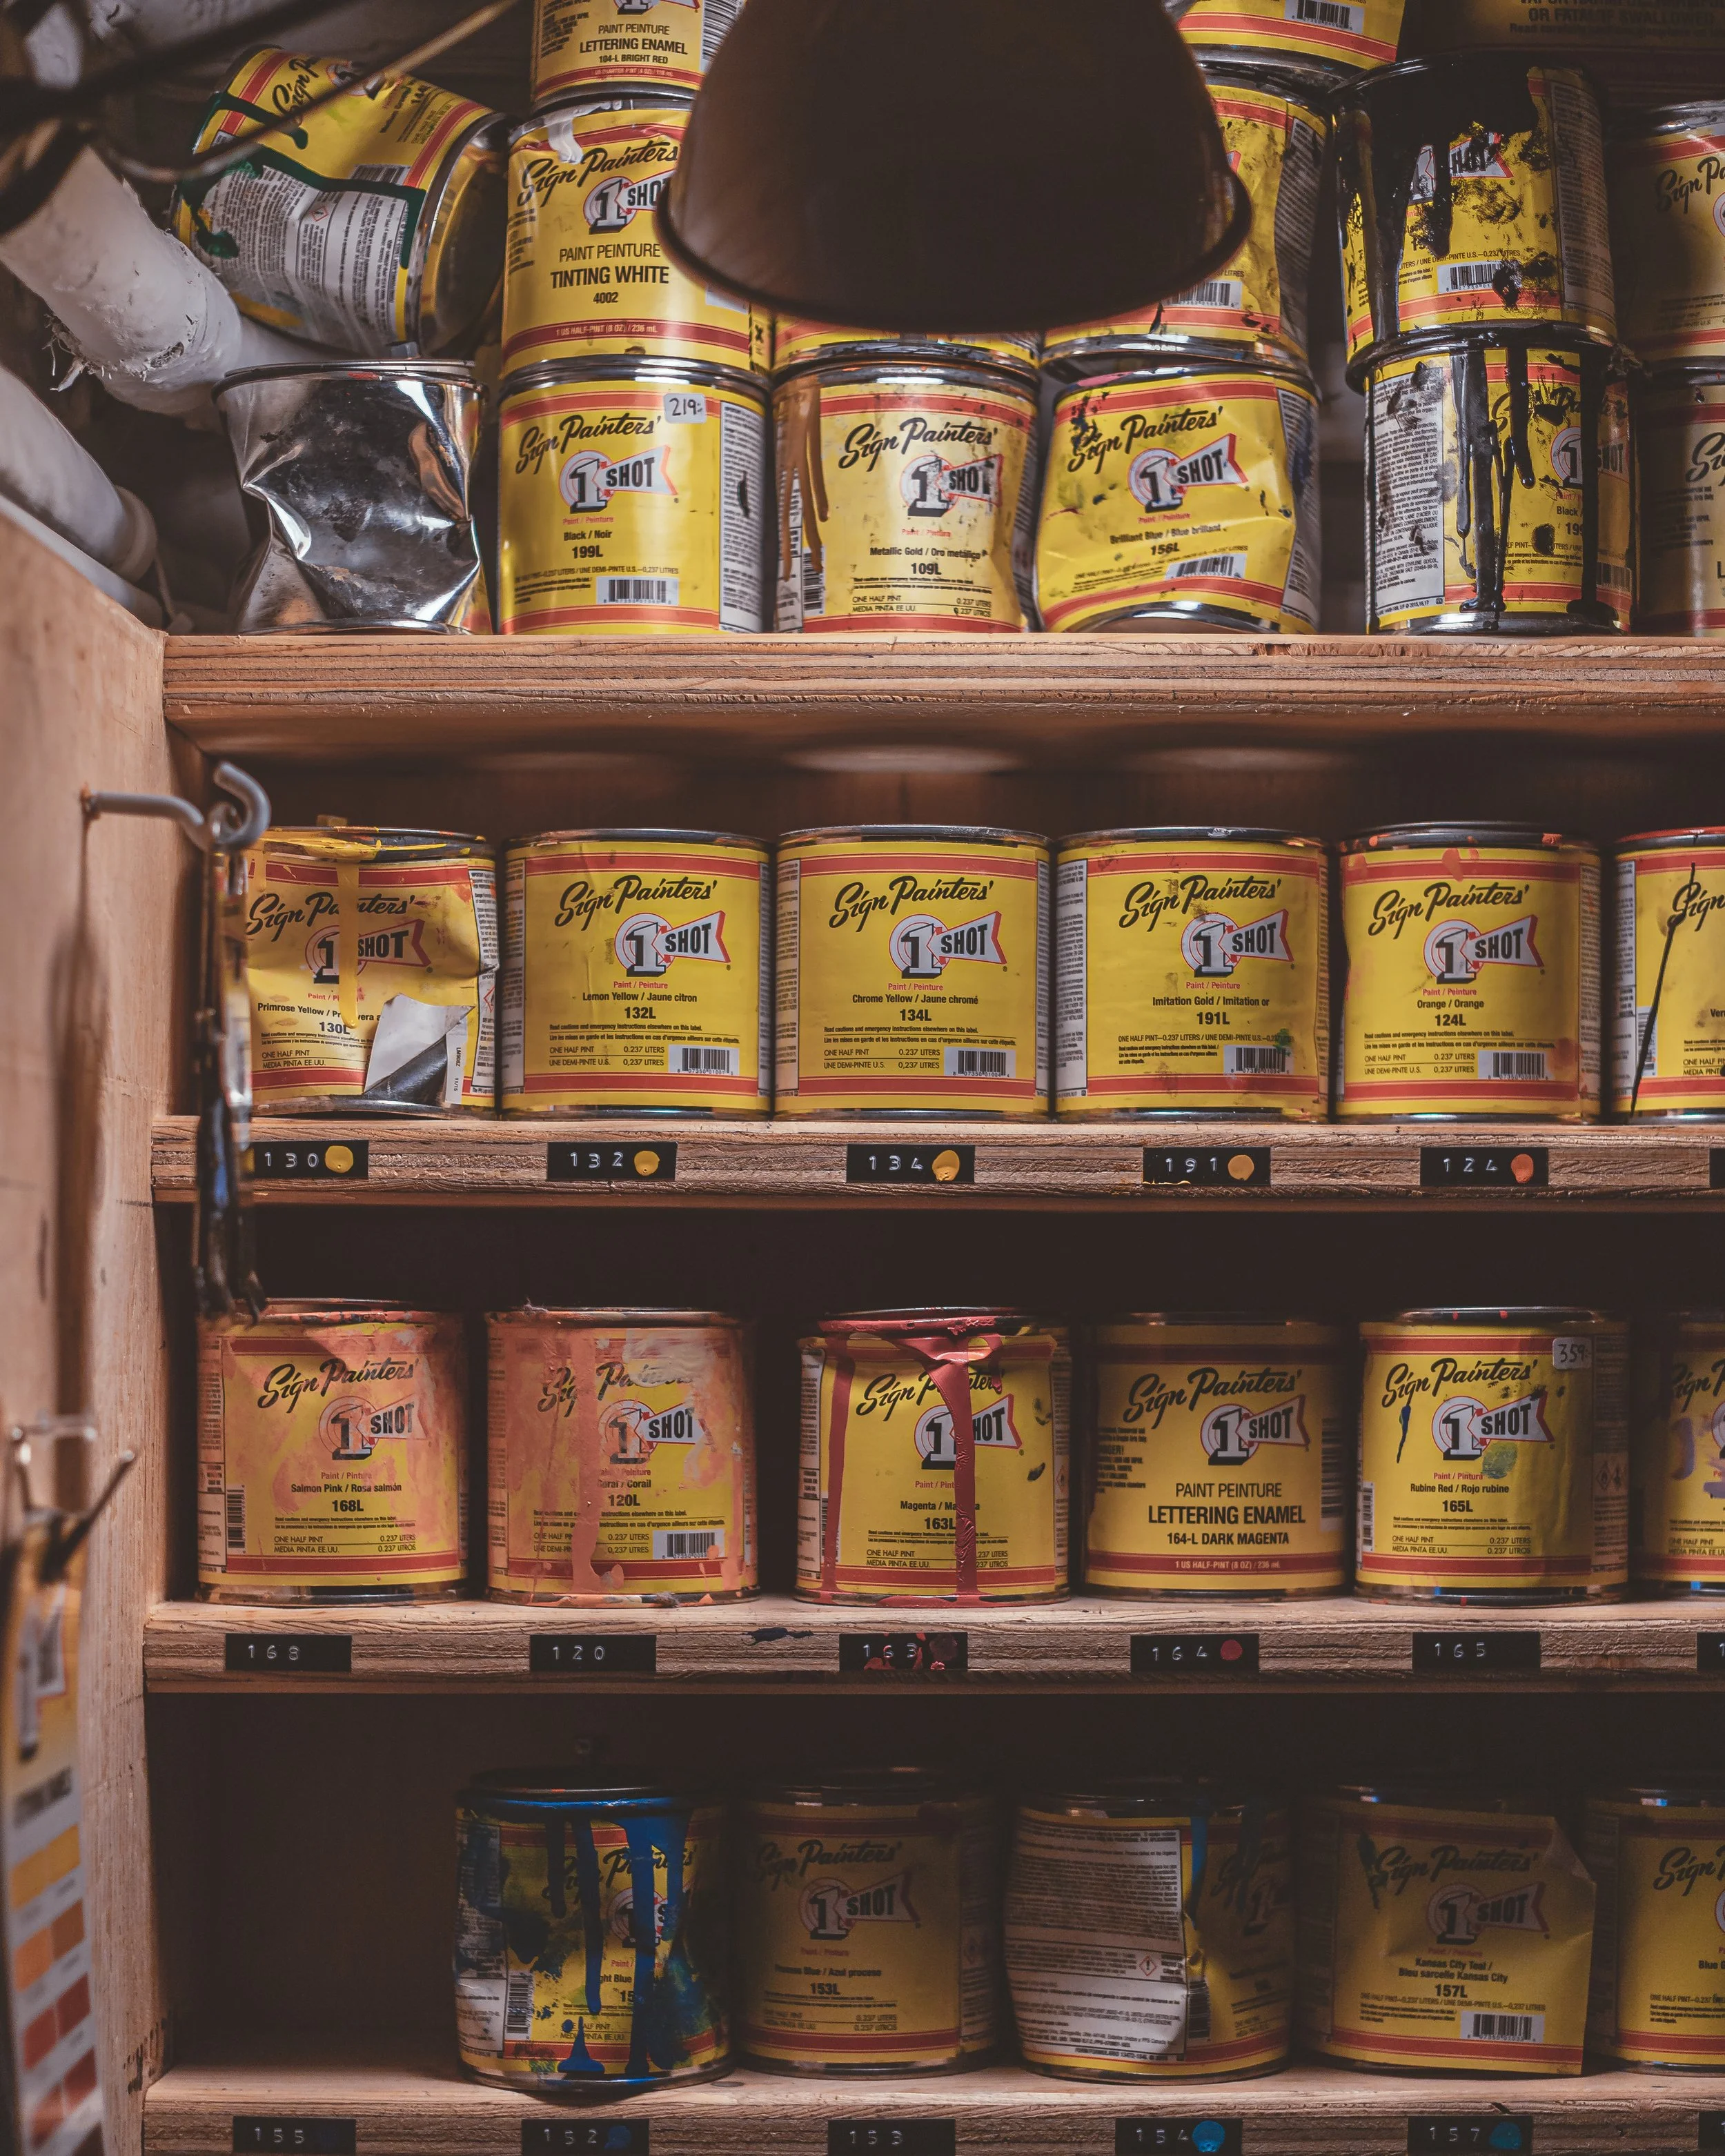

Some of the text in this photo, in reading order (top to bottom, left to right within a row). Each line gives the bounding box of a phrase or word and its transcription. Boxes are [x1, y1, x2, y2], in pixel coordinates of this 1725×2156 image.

[598, 24, 669, 35] PAINT PEINTURE
[580, 39, 688, 55] LETTERING ENAMEL
[600, 55, 620, 63] 104-L
[653, 56, 668, 64] RED
[518, 158, 577, 208] Sign
[560, 243, 660, 262] PAINT PEINTURE
[551, 266, 669, 289] TINTING WHITE
[593, 292, 618, 304] 4002
[1121, 406, 1223, 454] Painters'
[516, 413, 661, 475] Sign Painters'
[838, 423, 899, 472] Sign
[1178, 449, 1223, 484] SHOT
[949, 461, 995, 495] SHOT
[569, 457, 655, 514] 1 SHOT
[564, 531, 612, 541] Black Noir
[572, 546, 603, 559] 199L
[905, 547, 923, 556] Gold
[911, 563, 941, 575] 109L
[554, 875, 717, 931] Sign Painters'
[829, 876, 993, 932] Sign Painters'
[1119, 875, 1281, 931] Sign Painters'
[246, 893, 305, 942] Sign
[1368, 882, 1530, 940] Sign Painters'
[358, 930, 409, 958] SHOT
[625, 922, 711, 978] 1 SHOT
[1192, 922, 1276, 978] 1 SHOT
[901, 924, 987, 980] 1 SHOT
[1436, 928, 1524, 985] 1 SHOT
[582, 992, 697, 1002] Lemon Yellow Jaune citron
[852, 994, 978, 1005] Chrome Yellow Jaune chromé
[1152, 996, 1270, 1007] Imitation Gold Imitation or
[258, 1002, 324, 1015] Primrose Yellow
[1417, 999, 1484, 1010] Orange Orange
[624, 1007, 656, 1019] 132L
[900, 1009, 931, 1021] 134L
[1196, 1012, 1230, 1025] 191L
[1435, 1014, 1466, 1027] 124L
[319, 1021, 350, 1035] 130L
[257, 1363, 319, 1414] Sign
[1382, 1358, 1538, 1408] Sign Painters'
[856, 1373, 916, 1421] Sign
[1123, 1367, 1302, 1430] Sign Painters'
[371, 1403, 415, 1436] SHOT
[1208, 1407, 1294, 1465] 1 SHOT
[1443, 1403, 1531, 1460] 1 SHOT
[291, 1483, 402, 1493] Salmon Pink Rosa salmón
[1176, 1483, 1282, 1497] PAINT PEINTURE
[1410, 1483, 1509, 1494] Rubine Red Rojo rubine
[332, 1499, 364, 1512] 168L
[608, 1494, 640, 1507] 120L
[900, 1501, 936, 1511] Magenta
[1443, 1501, 1473, 1512] 165L
[1148, 1505, 1305, 1524] LETTERING ENAMEL
[925, 1517, 956, 1530] 163L
[1167, 1532, 1289, 1545] 164-L DARK MAGENTA
[1653, 1846, 1715, 1897] Sign
[846, 1884, 894, 1916] SHOT
[1478, 1894, 1529, 1923] SHOT
[1415, 1958, 1487, 1970] Kansas City Teal
[1698, 1959, 1717, 1970] Blue
[614, 1974, 632, 1984] Blue
[1457, 1972, 1489, 1982] Kansas
[1491, 1973, 1508, 1984] City
[810, 1982, 840, 1996] 153L
[1435, 1984, 1468, 1997] 157L
